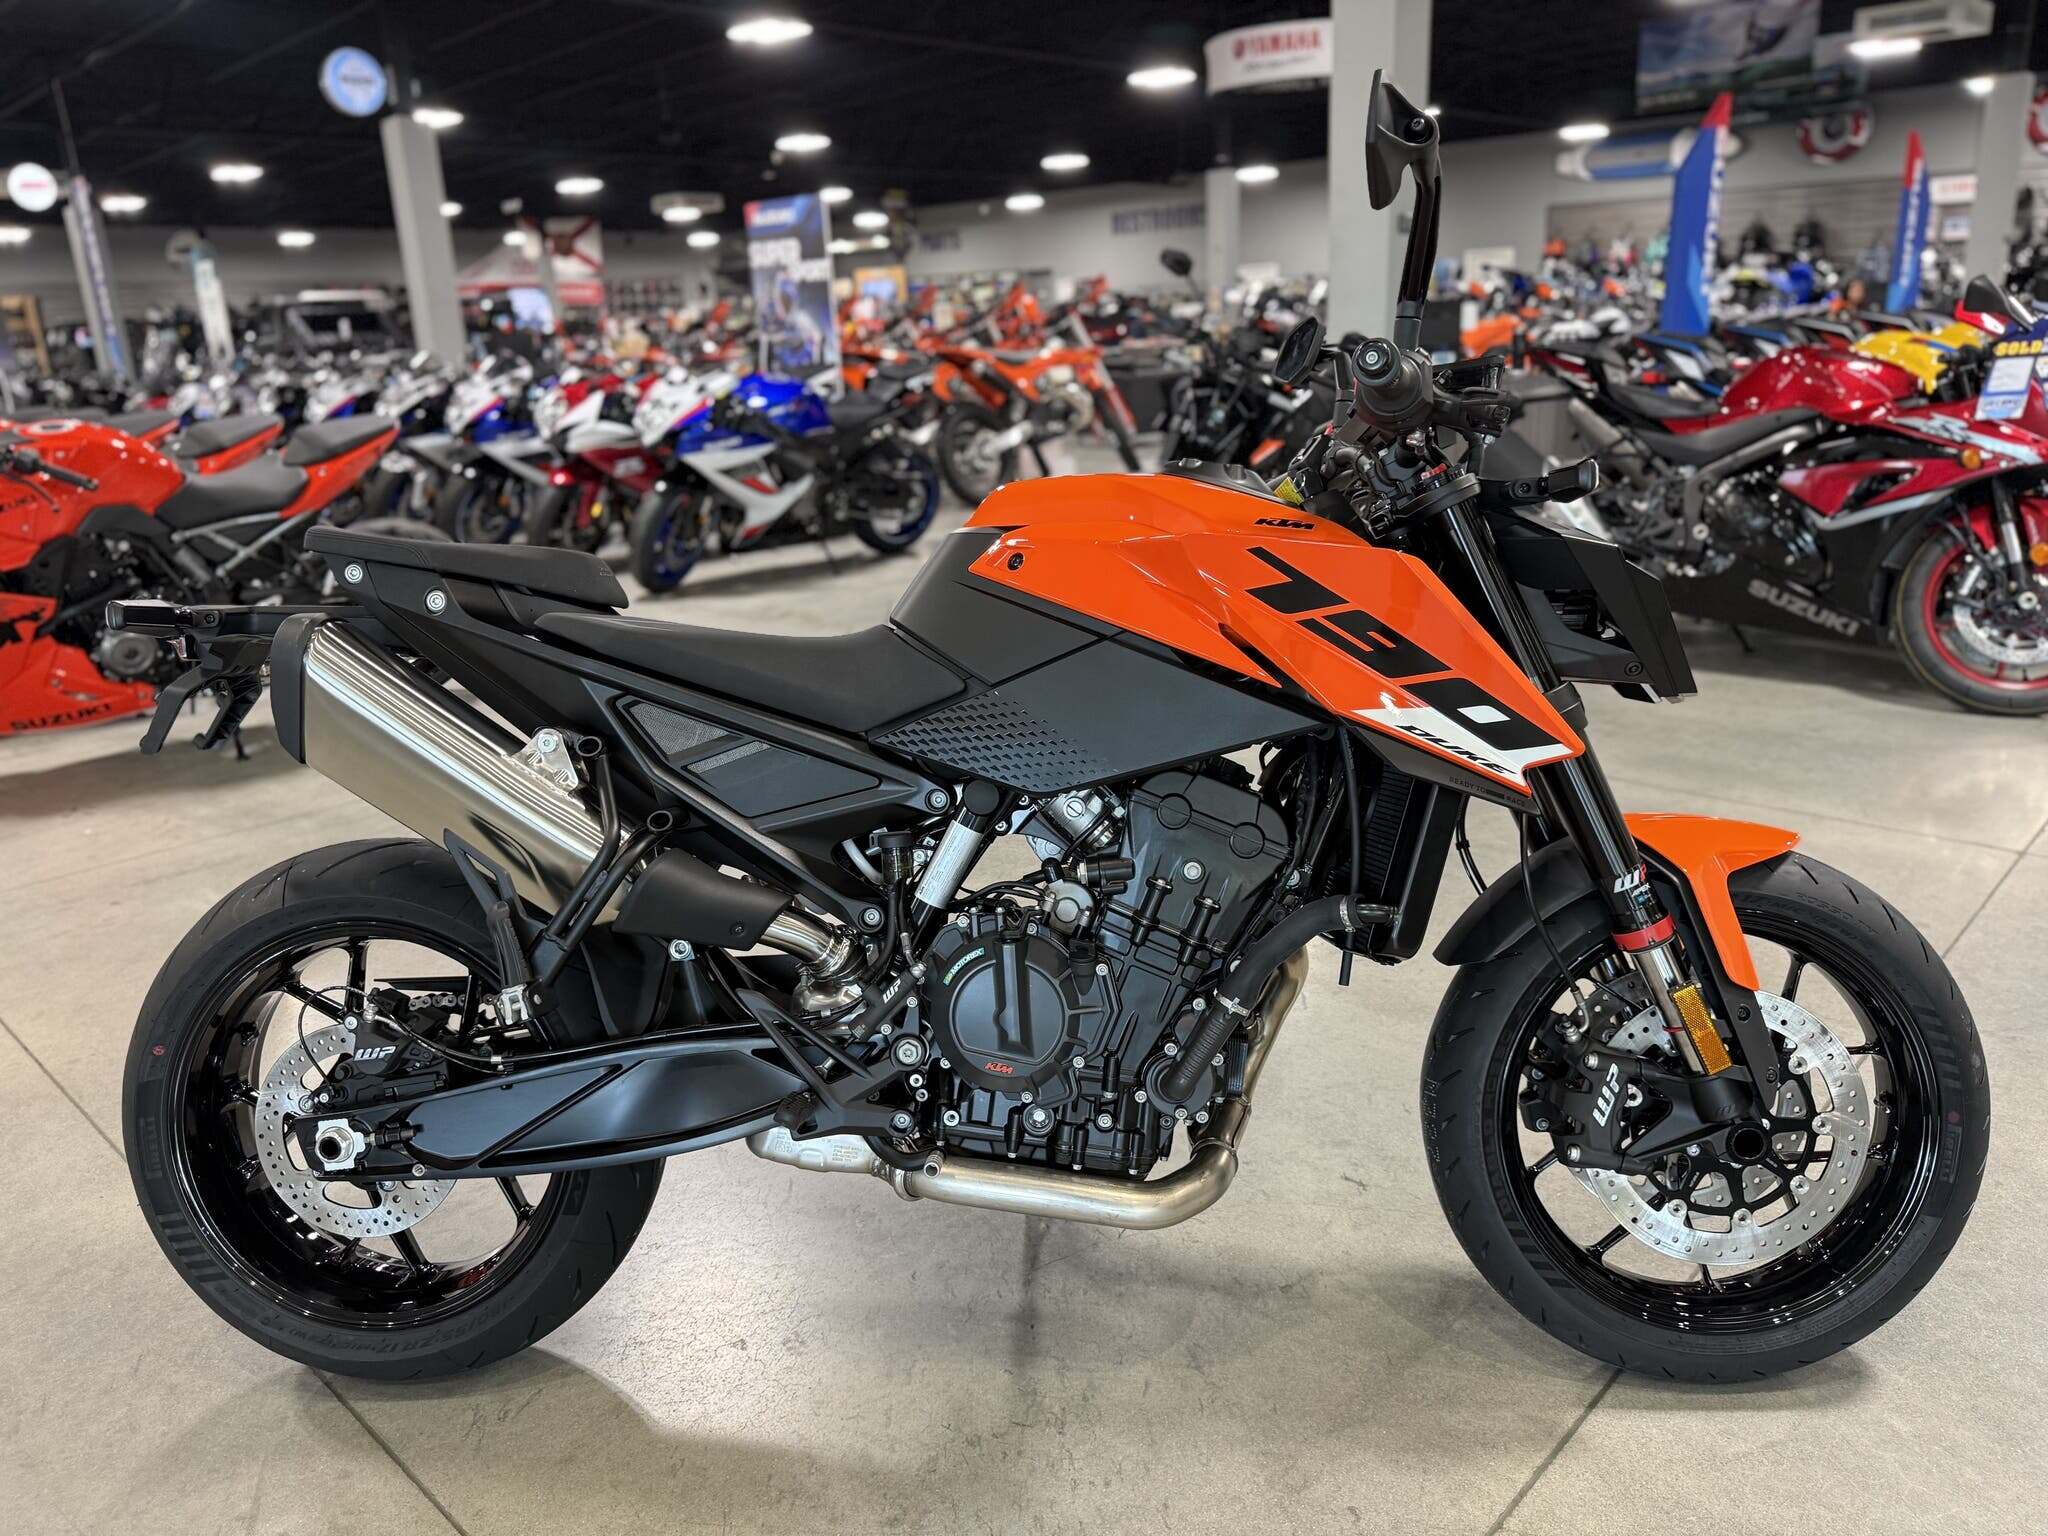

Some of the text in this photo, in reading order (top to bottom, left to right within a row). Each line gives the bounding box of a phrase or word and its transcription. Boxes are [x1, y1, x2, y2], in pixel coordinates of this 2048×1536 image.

[1254, 518, 1316, 530] KTM
[1748, 579, 1860, 637] SUZUKI
[1244, 546, 1563, 751] 790
[10, 703, 111, 730] SUZUKI
[1394, 725, 1517, 774] DUKE
[1613, 863, 1648, 894] WP
[951, 947, 985, 975] MOTOREX
[882, 978, 901, 1004] WP
[353, 1045, 397, 1061] WP
[984, 1062, 1015, 1074] KTM
[1592, 1062, 1620, 1128] WP
